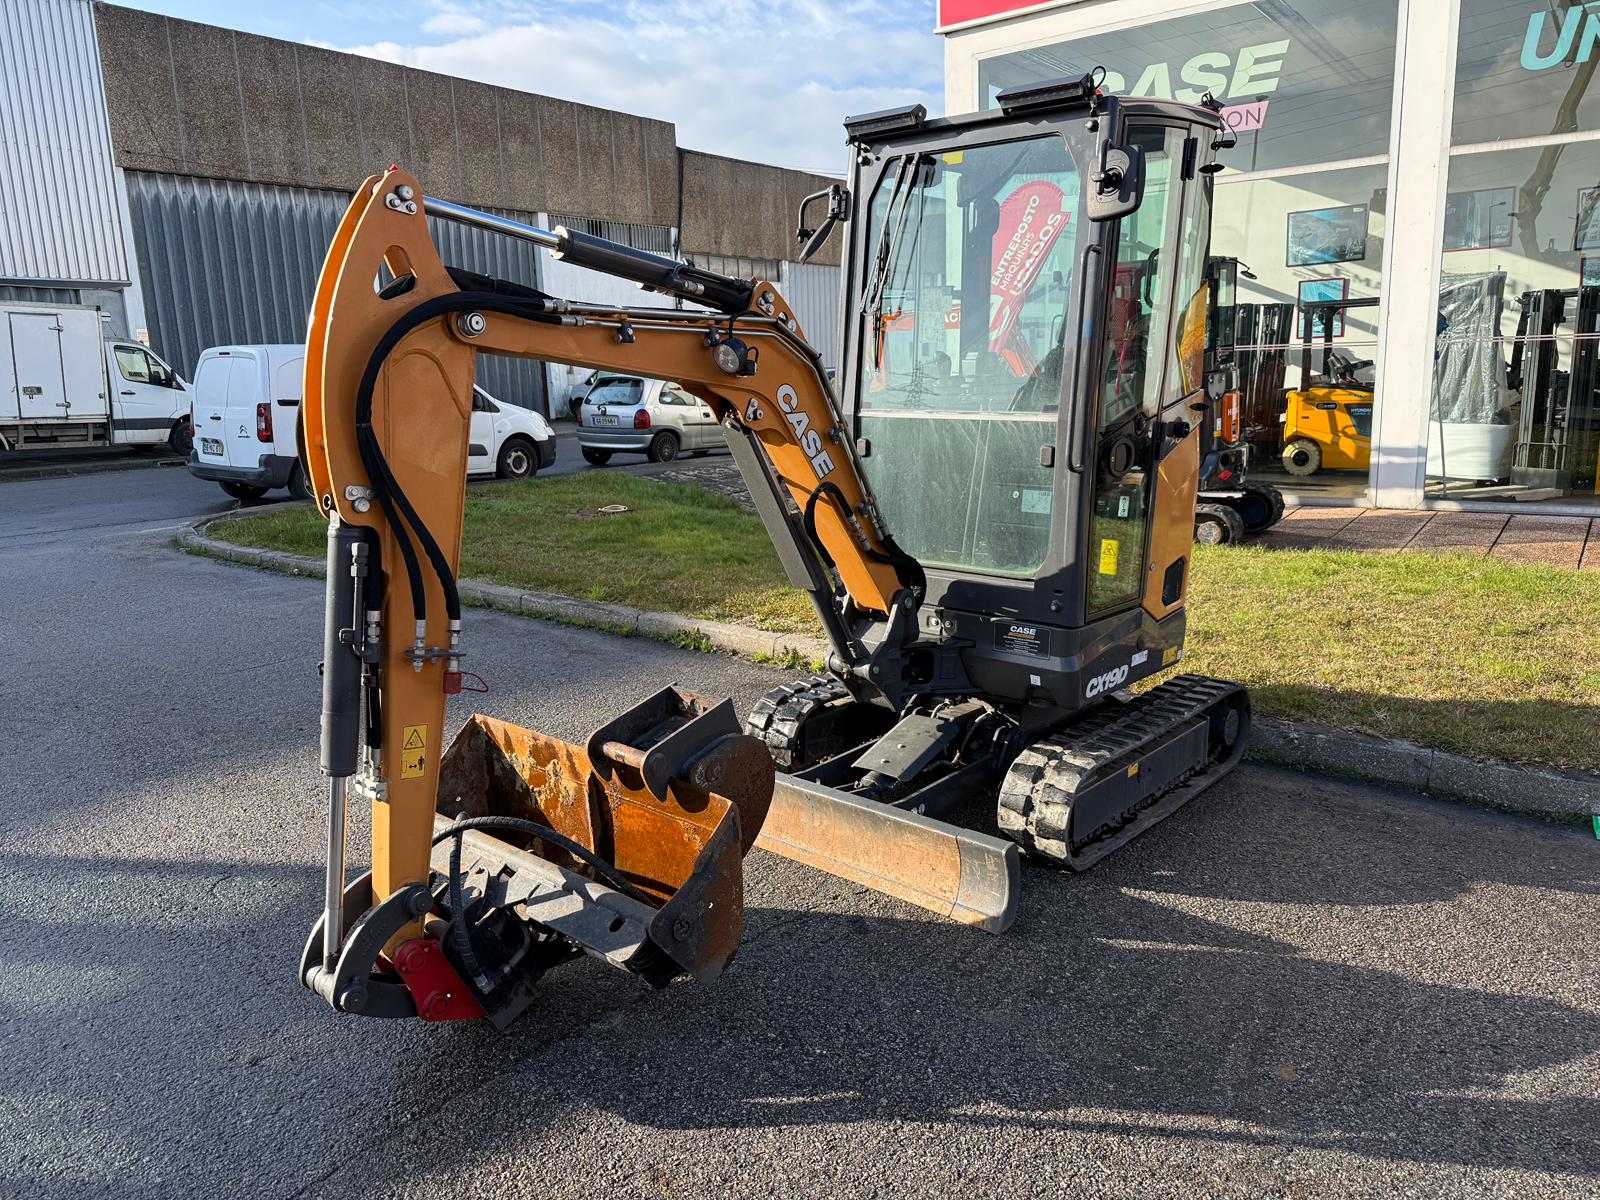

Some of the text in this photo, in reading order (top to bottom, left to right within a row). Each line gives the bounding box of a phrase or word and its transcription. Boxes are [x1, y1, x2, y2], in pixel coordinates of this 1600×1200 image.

[991, 194, 1041, 286] ENTREPOSTO
[1000, 231, 1035, 291] MÁQUINAS
[776, 384, 835, 480] CASE
[1010, 625, 1037, 636] CASE
[1085, 664, 1129, 699] CX19D
